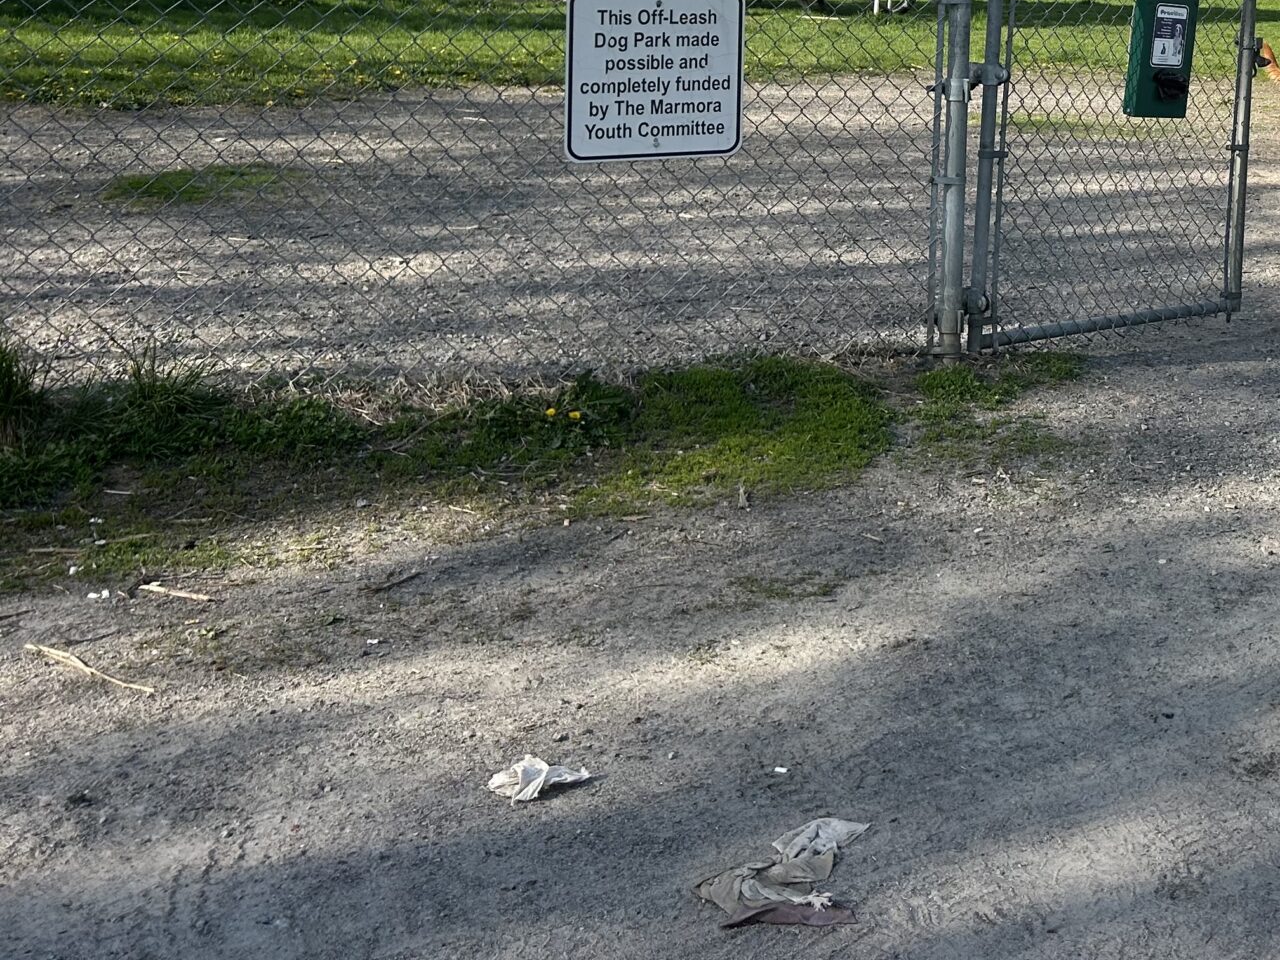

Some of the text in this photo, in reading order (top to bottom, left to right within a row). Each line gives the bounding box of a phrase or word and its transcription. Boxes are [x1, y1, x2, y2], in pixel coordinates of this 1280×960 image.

[597, 9, 717, 26] This Off-Leash
[594, 31, 720, 52] Dog Park made
[605, 53, 709, 74] possible and
[580, 75, 731, 97] completely funded
[589, 99, 722, 121] by The Marmora
[584, 120, 725, 140] Youth Committee
